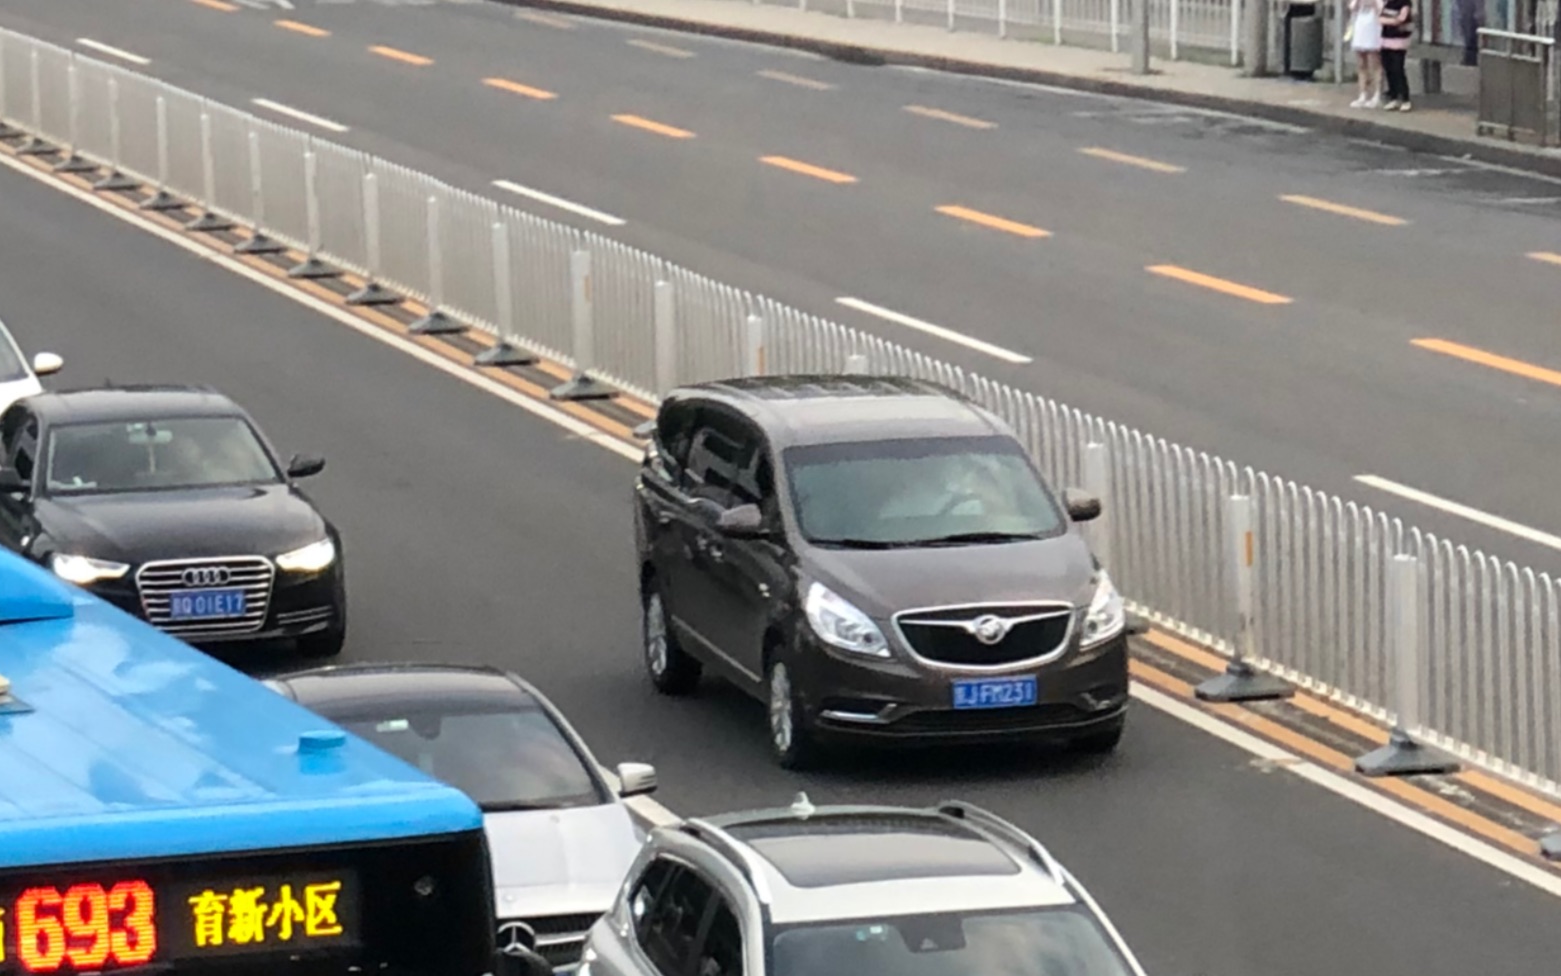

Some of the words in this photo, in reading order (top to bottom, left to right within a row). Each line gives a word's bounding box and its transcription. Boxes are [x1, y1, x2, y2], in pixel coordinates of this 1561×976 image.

[15, 880, 157, 972] 693
[188, 881, 343, 946] 育新小区
